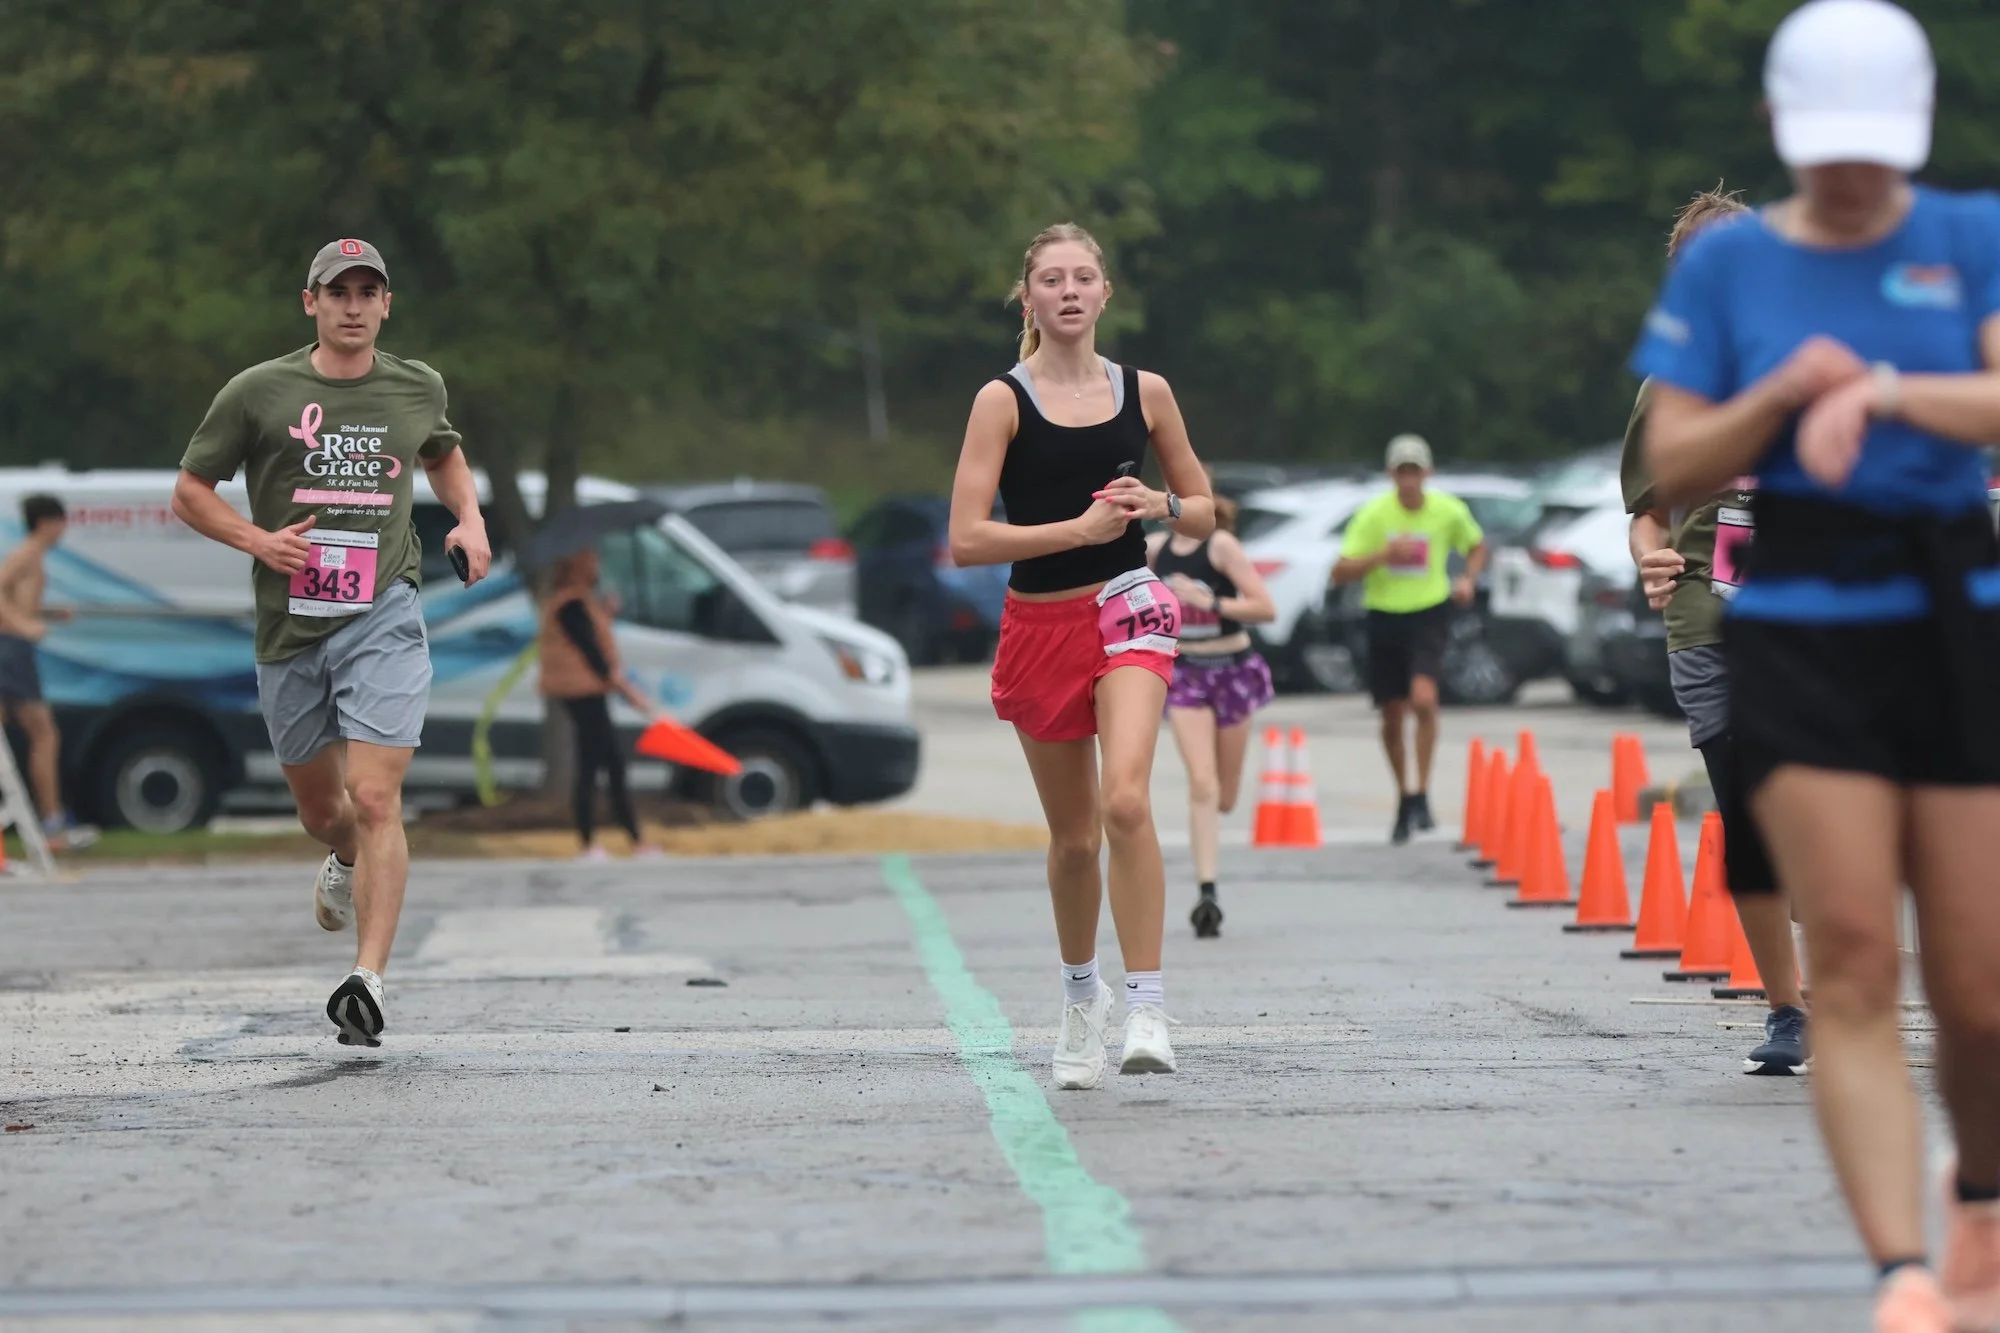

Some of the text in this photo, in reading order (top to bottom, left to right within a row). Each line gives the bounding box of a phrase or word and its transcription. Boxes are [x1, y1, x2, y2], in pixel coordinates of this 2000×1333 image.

[340, 424, 388, 433] 22nd Annual
[321, 433, 382, 460] Race
[303, 450, 382, 477] Grace
[326, 479, 338, 487] 5K
[338, 479, 345, 487] &
[362, 480, 379, 488] Walk
[326, 506, 364, 516] September
[304, 567, 361, 600] 343
[1116, 603, 1175, 640] 755
